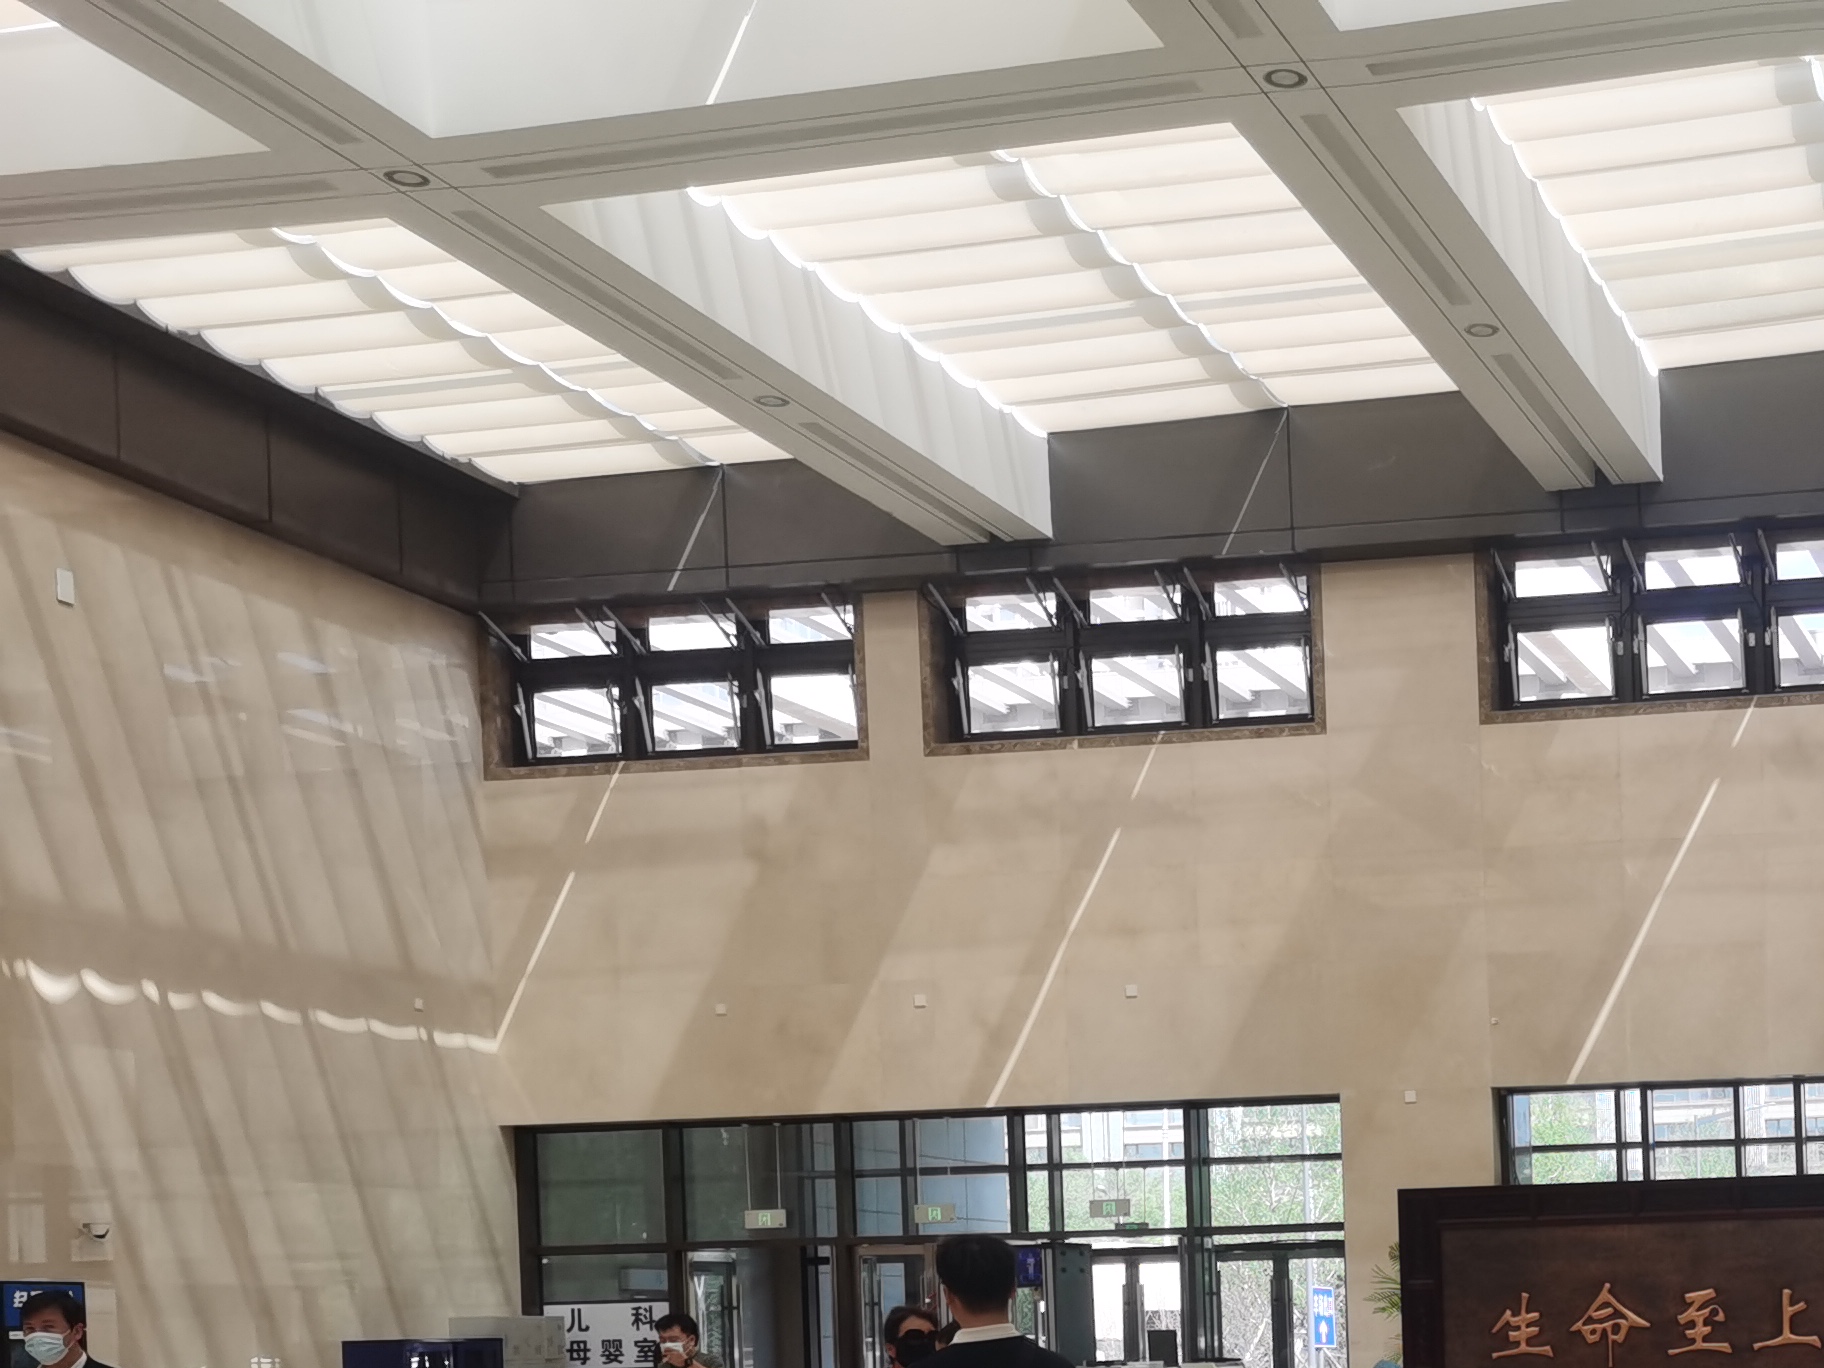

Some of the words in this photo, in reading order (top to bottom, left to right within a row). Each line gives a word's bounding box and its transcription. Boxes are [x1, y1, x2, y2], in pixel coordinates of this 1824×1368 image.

[566, 1305, 656, 1333] 儿科
[1491, 1282, 1822, 1368] 生命至上
[566, 1338, 656, 1366] 母婴室
